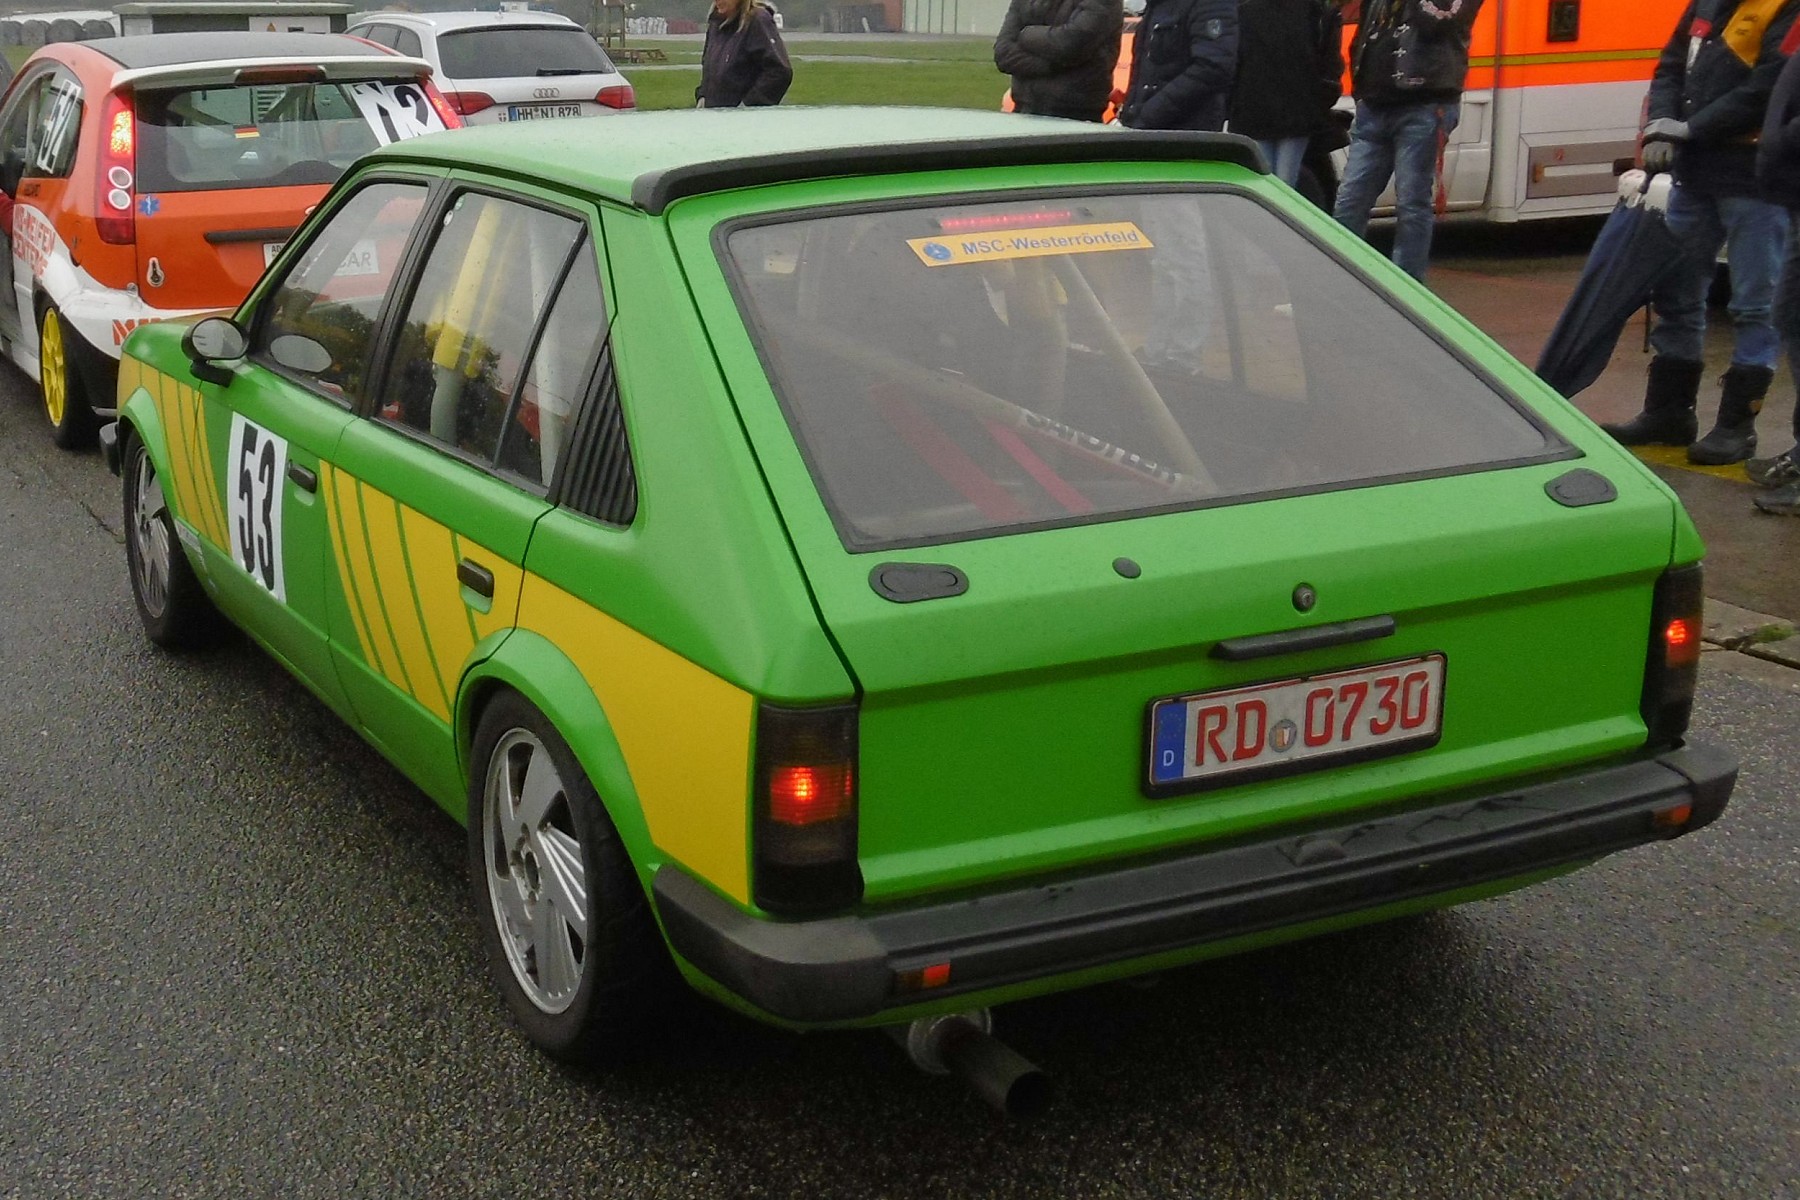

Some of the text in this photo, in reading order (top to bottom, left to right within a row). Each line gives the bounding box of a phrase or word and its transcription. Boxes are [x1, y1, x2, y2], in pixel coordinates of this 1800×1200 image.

[517, 107, 534, 121] HH
[540, 107, 555, 119] NI
[961, 230, 1139, 254] MSC-Westerrönfeld
[239, 421, 275, 592] 53
[1163, 670, 1430, 767] D RD 0730
